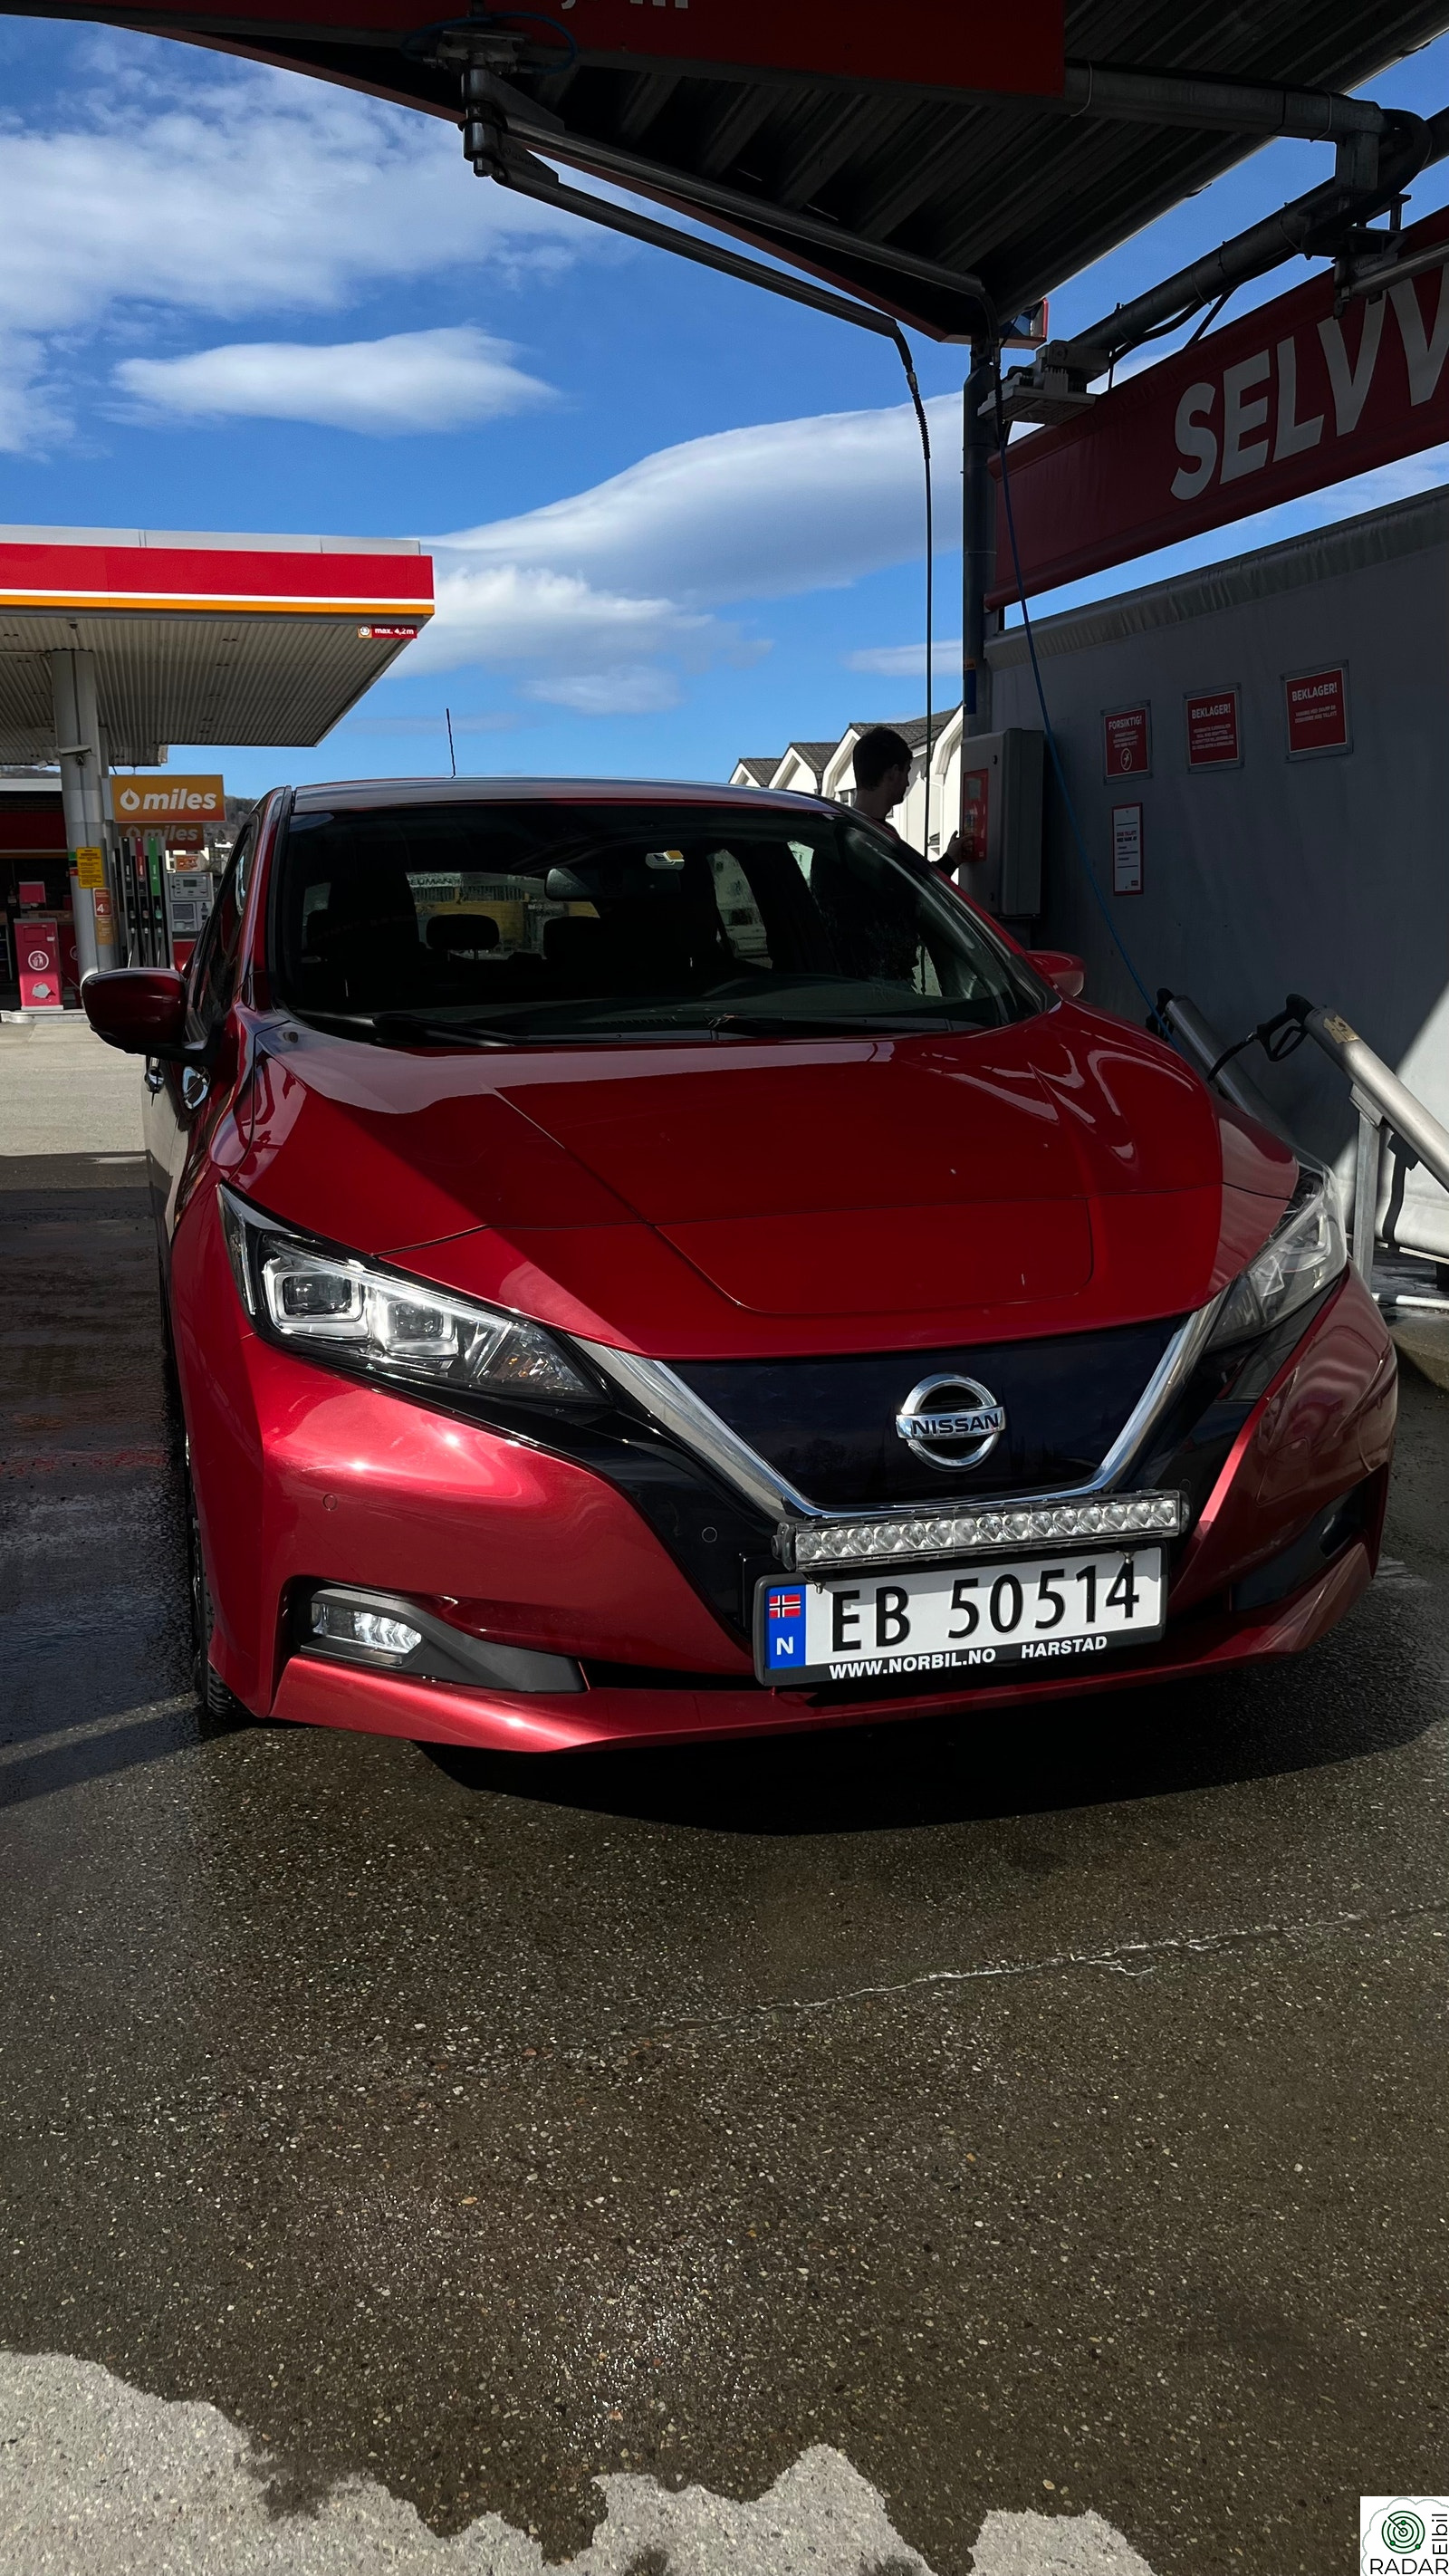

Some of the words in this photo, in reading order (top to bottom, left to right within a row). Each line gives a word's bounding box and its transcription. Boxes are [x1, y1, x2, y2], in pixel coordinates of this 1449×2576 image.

[1291, 681, 1338, 702] BEKLAGER!
[1191, 703, 1231, 720] BEKLAGER!
[1108, 715, 1143, 731] FORSIKTIG!
[143, 788, 217, 810] miles
[911, 1412, 1001, 1437] NISSAN
[831, 1586, 911, 1652] EB
[948, 1560, 1140, 1640] 50514
[776, 1636, 794, 1656] N
[829, 1647, 996, 1680] WWW.NORBIL.NO
[1021, 1635, 1108, 1658] HARSTAD
